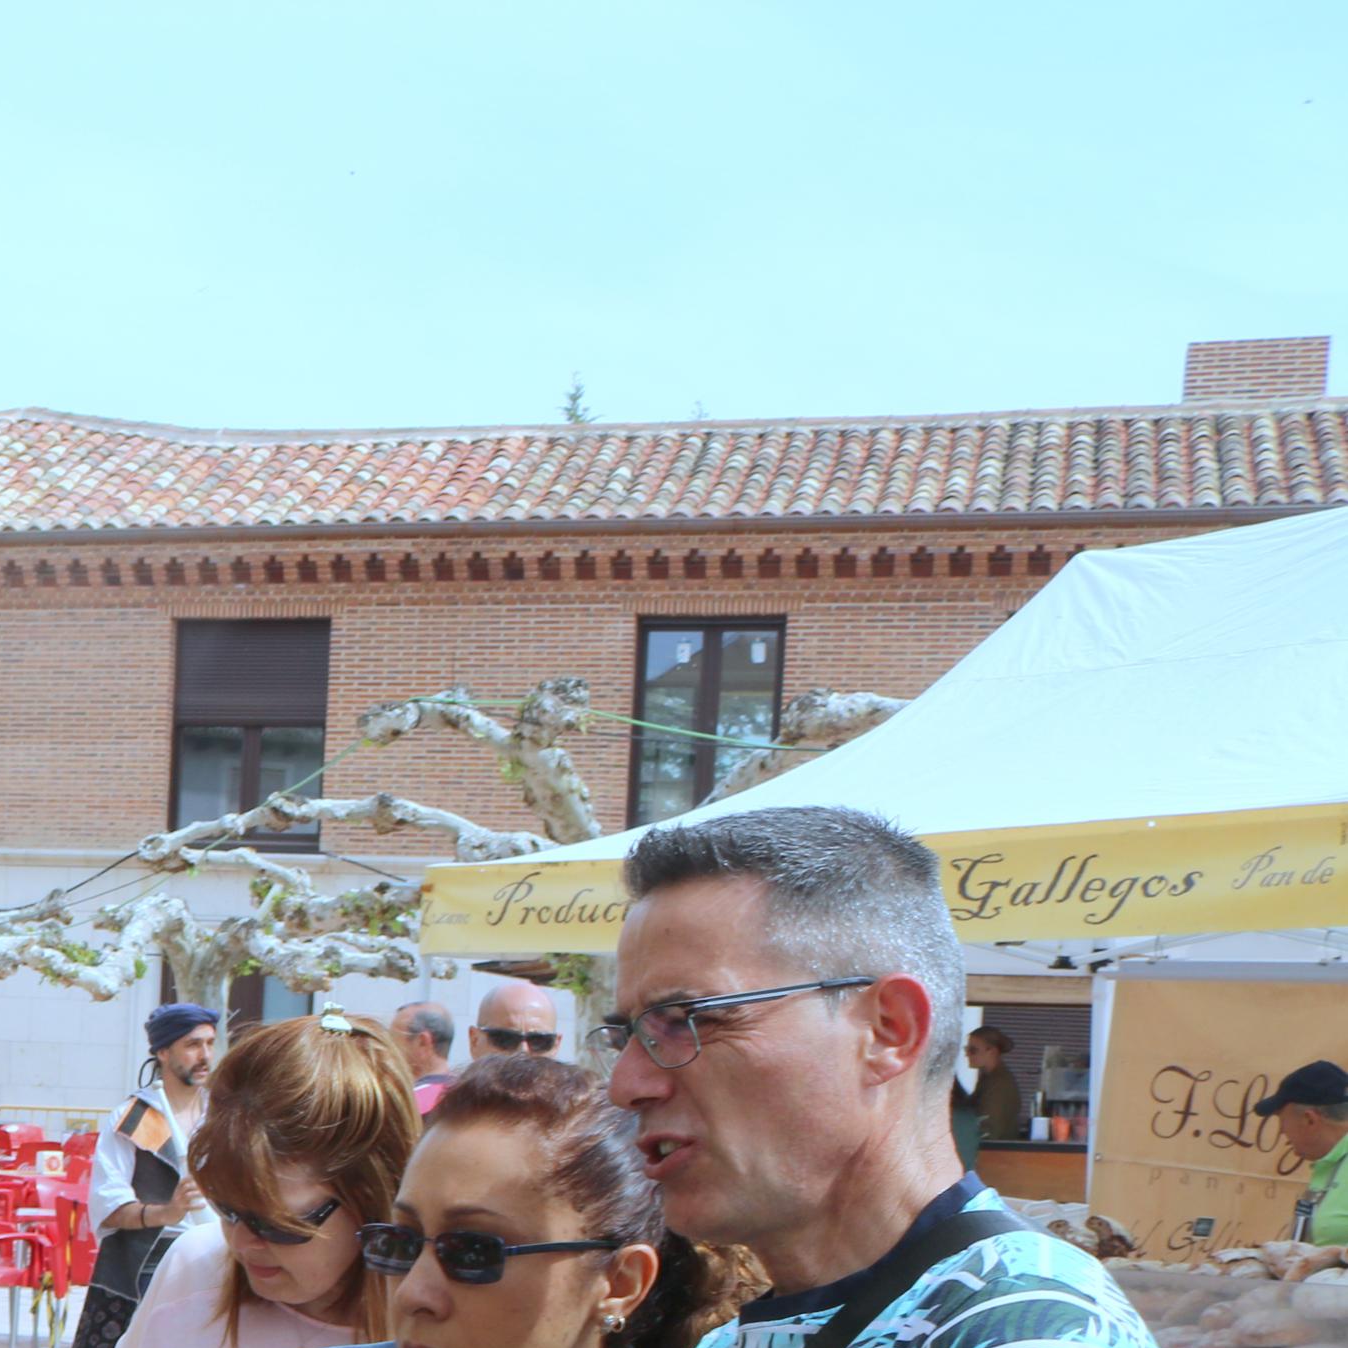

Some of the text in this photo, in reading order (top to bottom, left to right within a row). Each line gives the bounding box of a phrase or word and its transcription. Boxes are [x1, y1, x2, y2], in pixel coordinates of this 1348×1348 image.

[949, 845, 1336, 926] Gallegos Pan de
